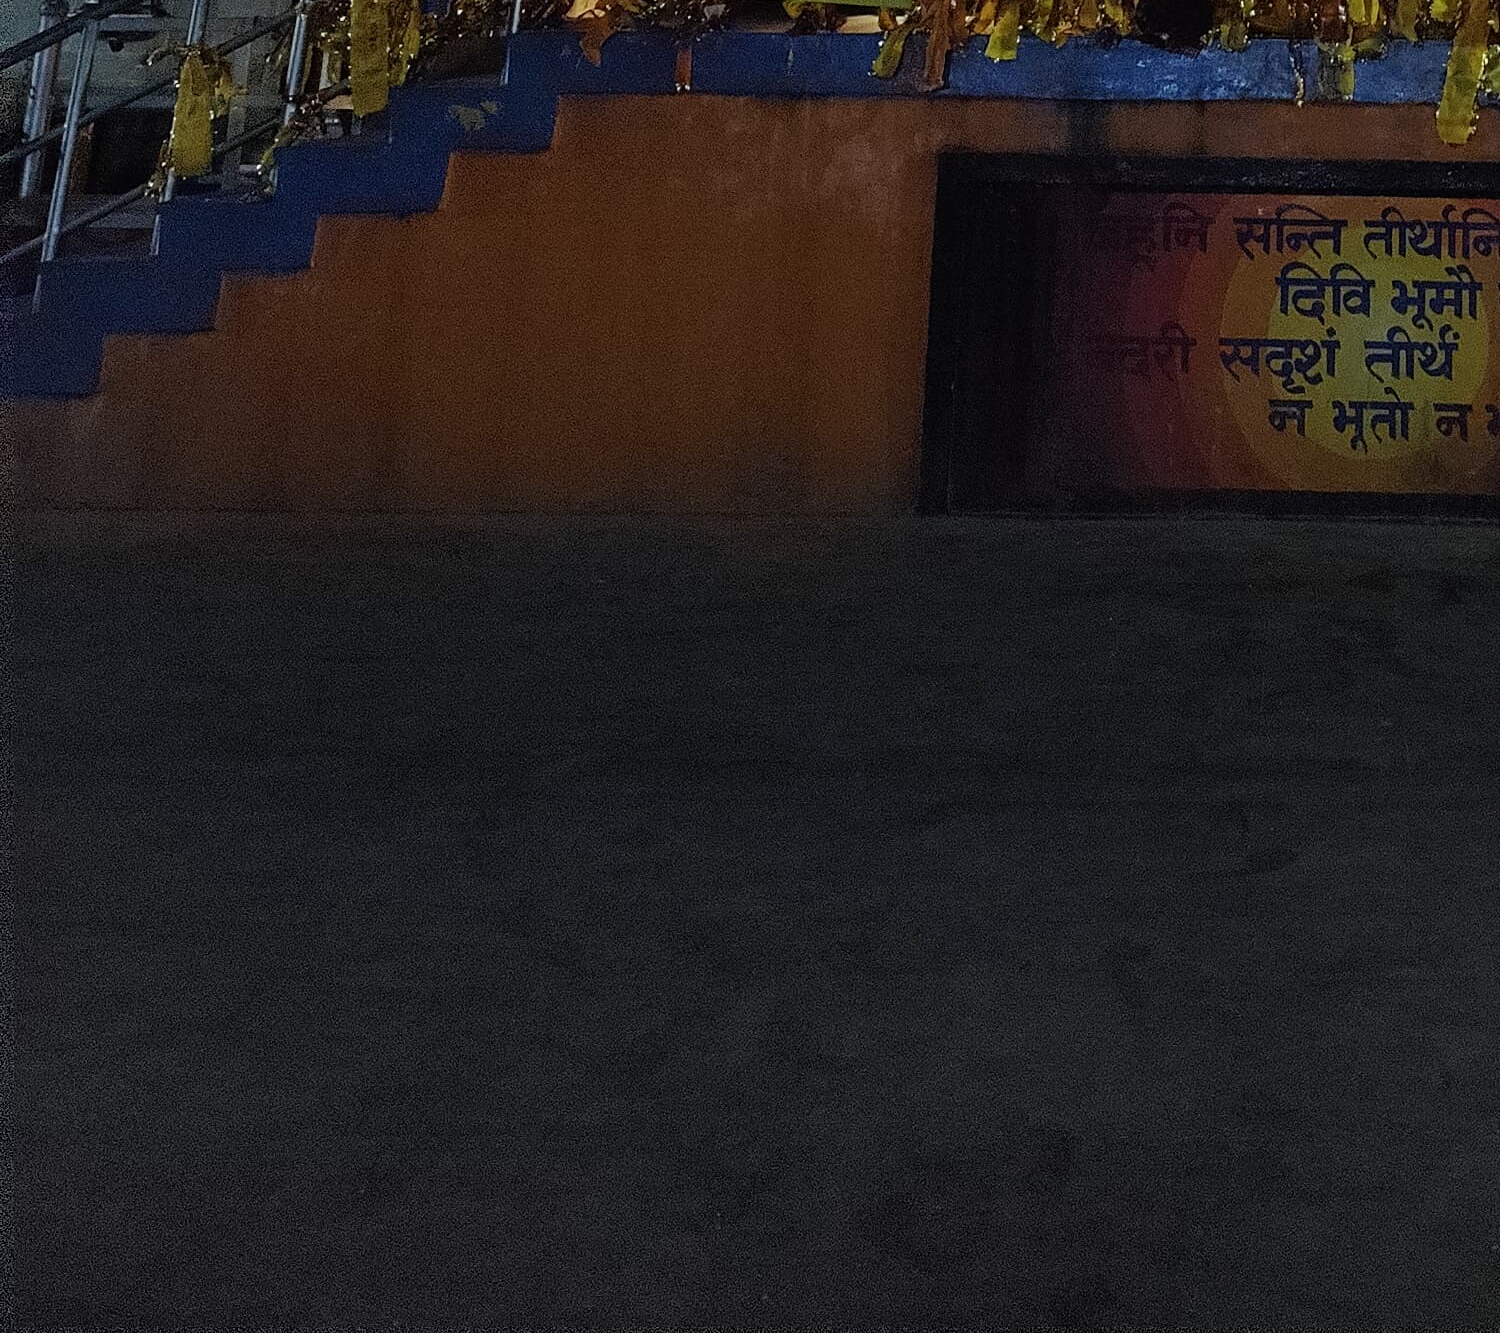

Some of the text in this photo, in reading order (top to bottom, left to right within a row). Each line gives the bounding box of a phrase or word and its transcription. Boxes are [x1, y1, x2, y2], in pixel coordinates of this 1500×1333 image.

[1232, 203, 1348, 260] सन्ति
[1275, 261, 1376, 326] दिवि
[1391, 264, 1484, 331] भूमौ
[1219, 326, 1341, 394] सदृशं
[1363, 323, 1460, 382] तीर्थं
[1268, 398, 1313, 437] न
[1331, 386, 1414, 453] भूतो
[1433, 402, 1473, 442] न
